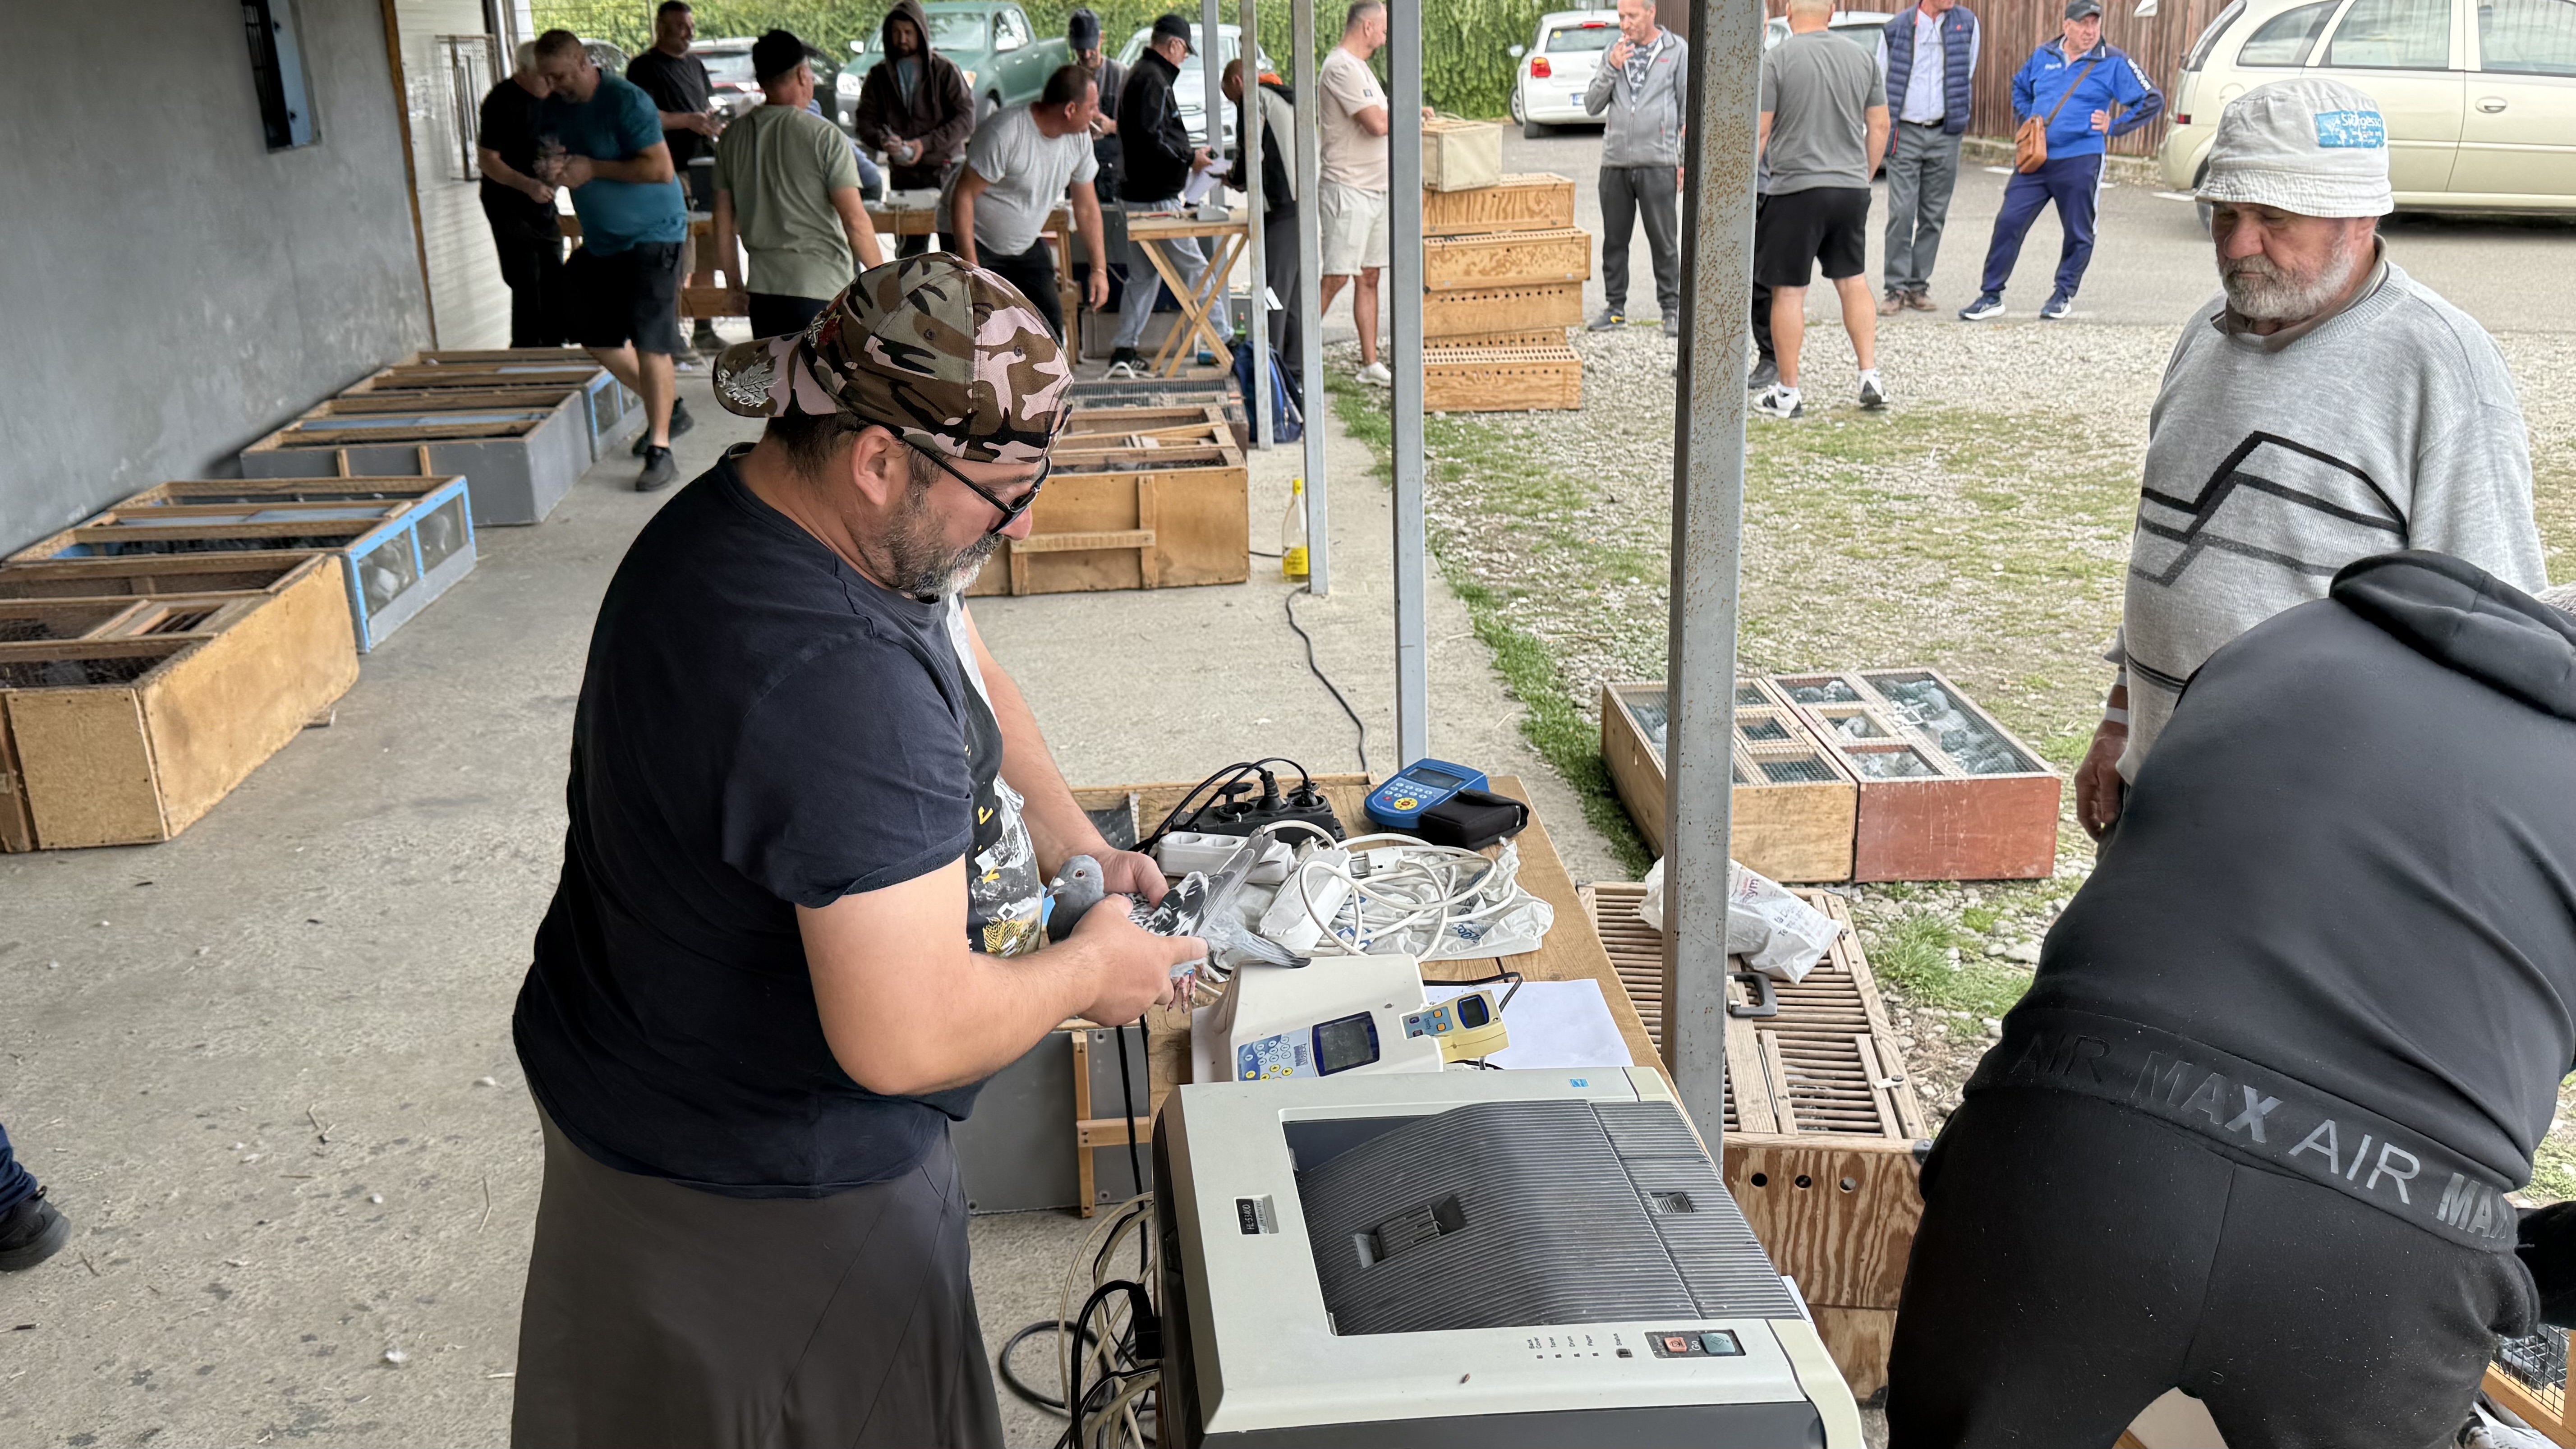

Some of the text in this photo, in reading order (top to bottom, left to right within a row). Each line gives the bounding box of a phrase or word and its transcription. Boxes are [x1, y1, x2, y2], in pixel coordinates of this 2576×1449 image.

[2011, 1033, 2112, 1084] AIR
[2130, 1050, 2283, 1144] MAX
[2288, 1119, 2421, 1205] AIR
[1534, 1337, 1542, 1349] Cover
[1549, 1337, 1557, 1348] Toner
[1567, 1335, 1575, 1347] Drum
[1585, 1334, 1593, 1346] Paper
[1613, 1333, 1622, 1346] Status
[1691, 1340, 1701, 1351] Go
